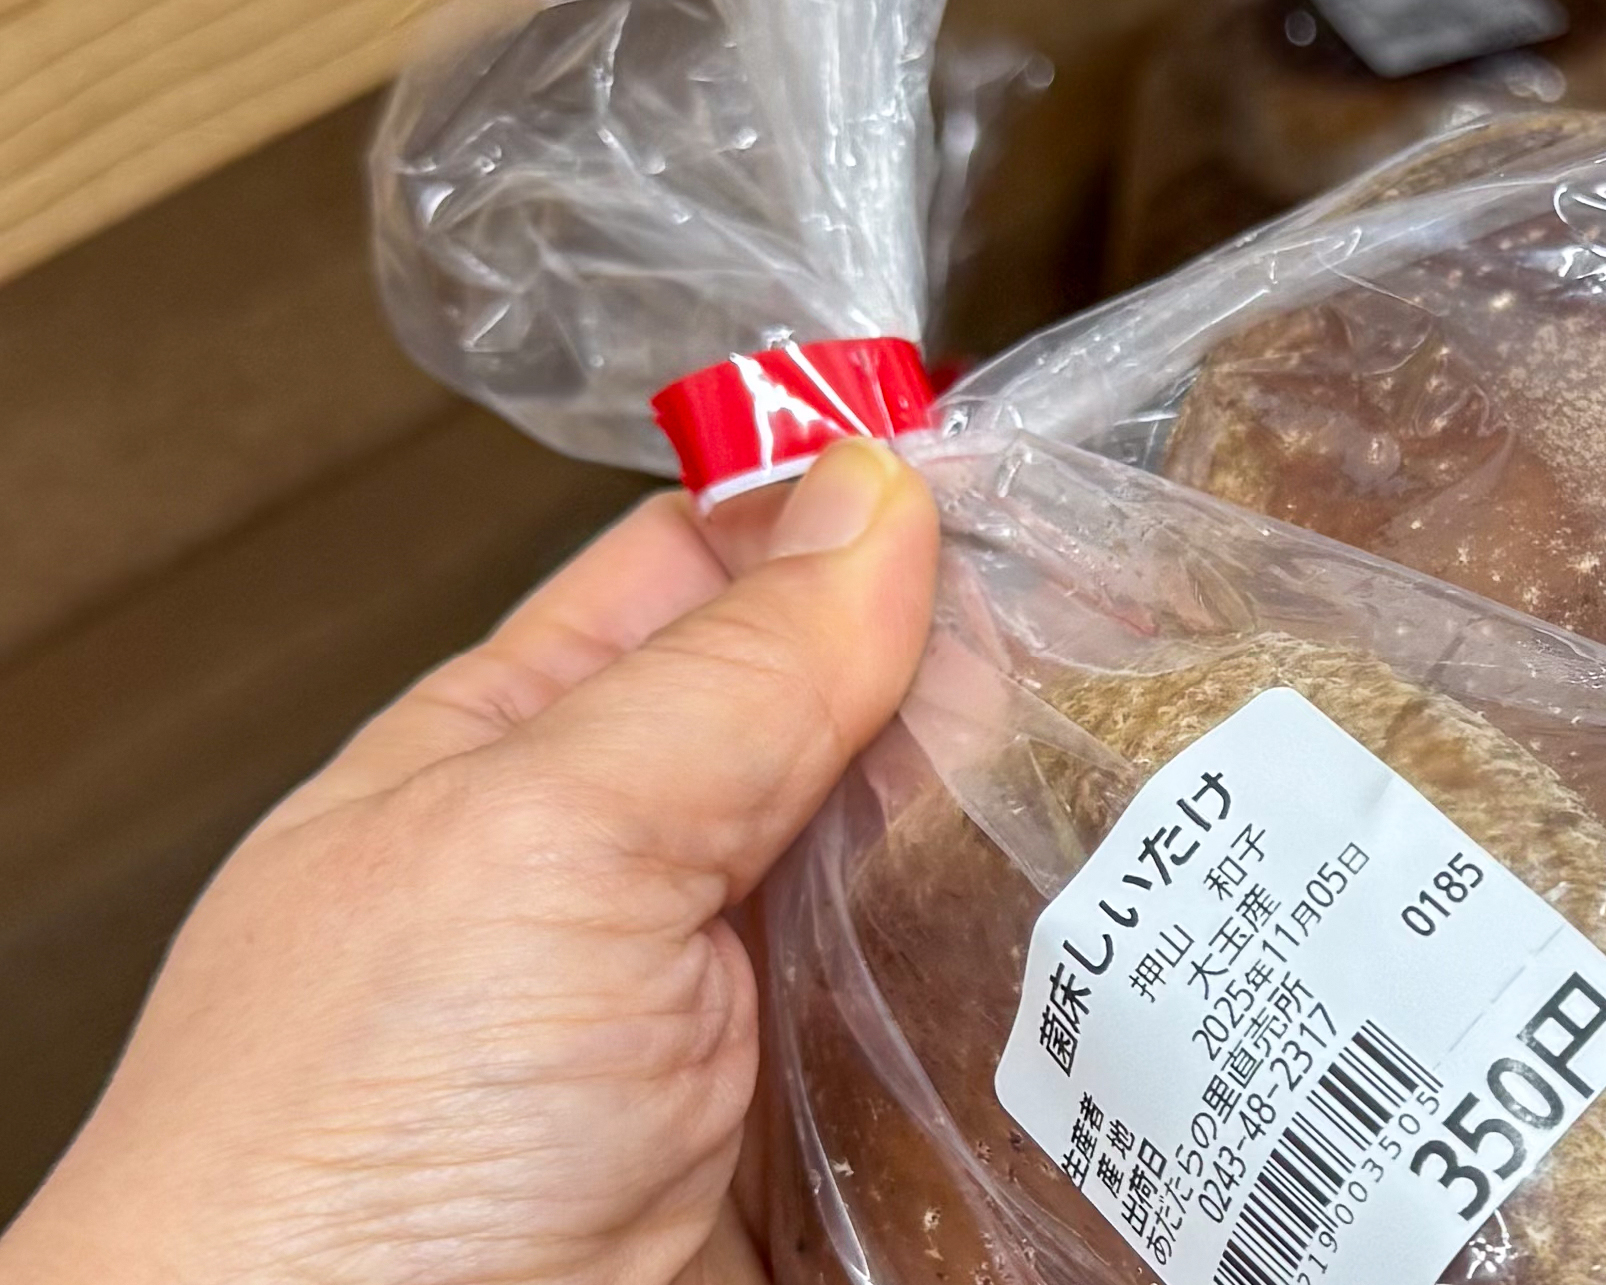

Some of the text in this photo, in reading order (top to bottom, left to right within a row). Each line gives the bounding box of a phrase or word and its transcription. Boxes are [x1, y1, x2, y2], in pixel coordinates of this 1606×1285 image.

[1039, 772, 1231, 1078] 菌床しいたけ
[1128, 823, 1267, 1003] 押山 和子
[1187, 883, 1282, 1001] 大玉産
[1191, 842, 1370, 1062] 2025年11月05日
[1401, 852, 1484, 937] 0185
[1058, 1092, 1105, 1186] 生産者
[1120, 1137, 1168, 1237] 出荷日
[1146, 971, 1315, 1266] あだたらの里直売所
[1198, 1002, 1338, 1224] 0243-48-2317
